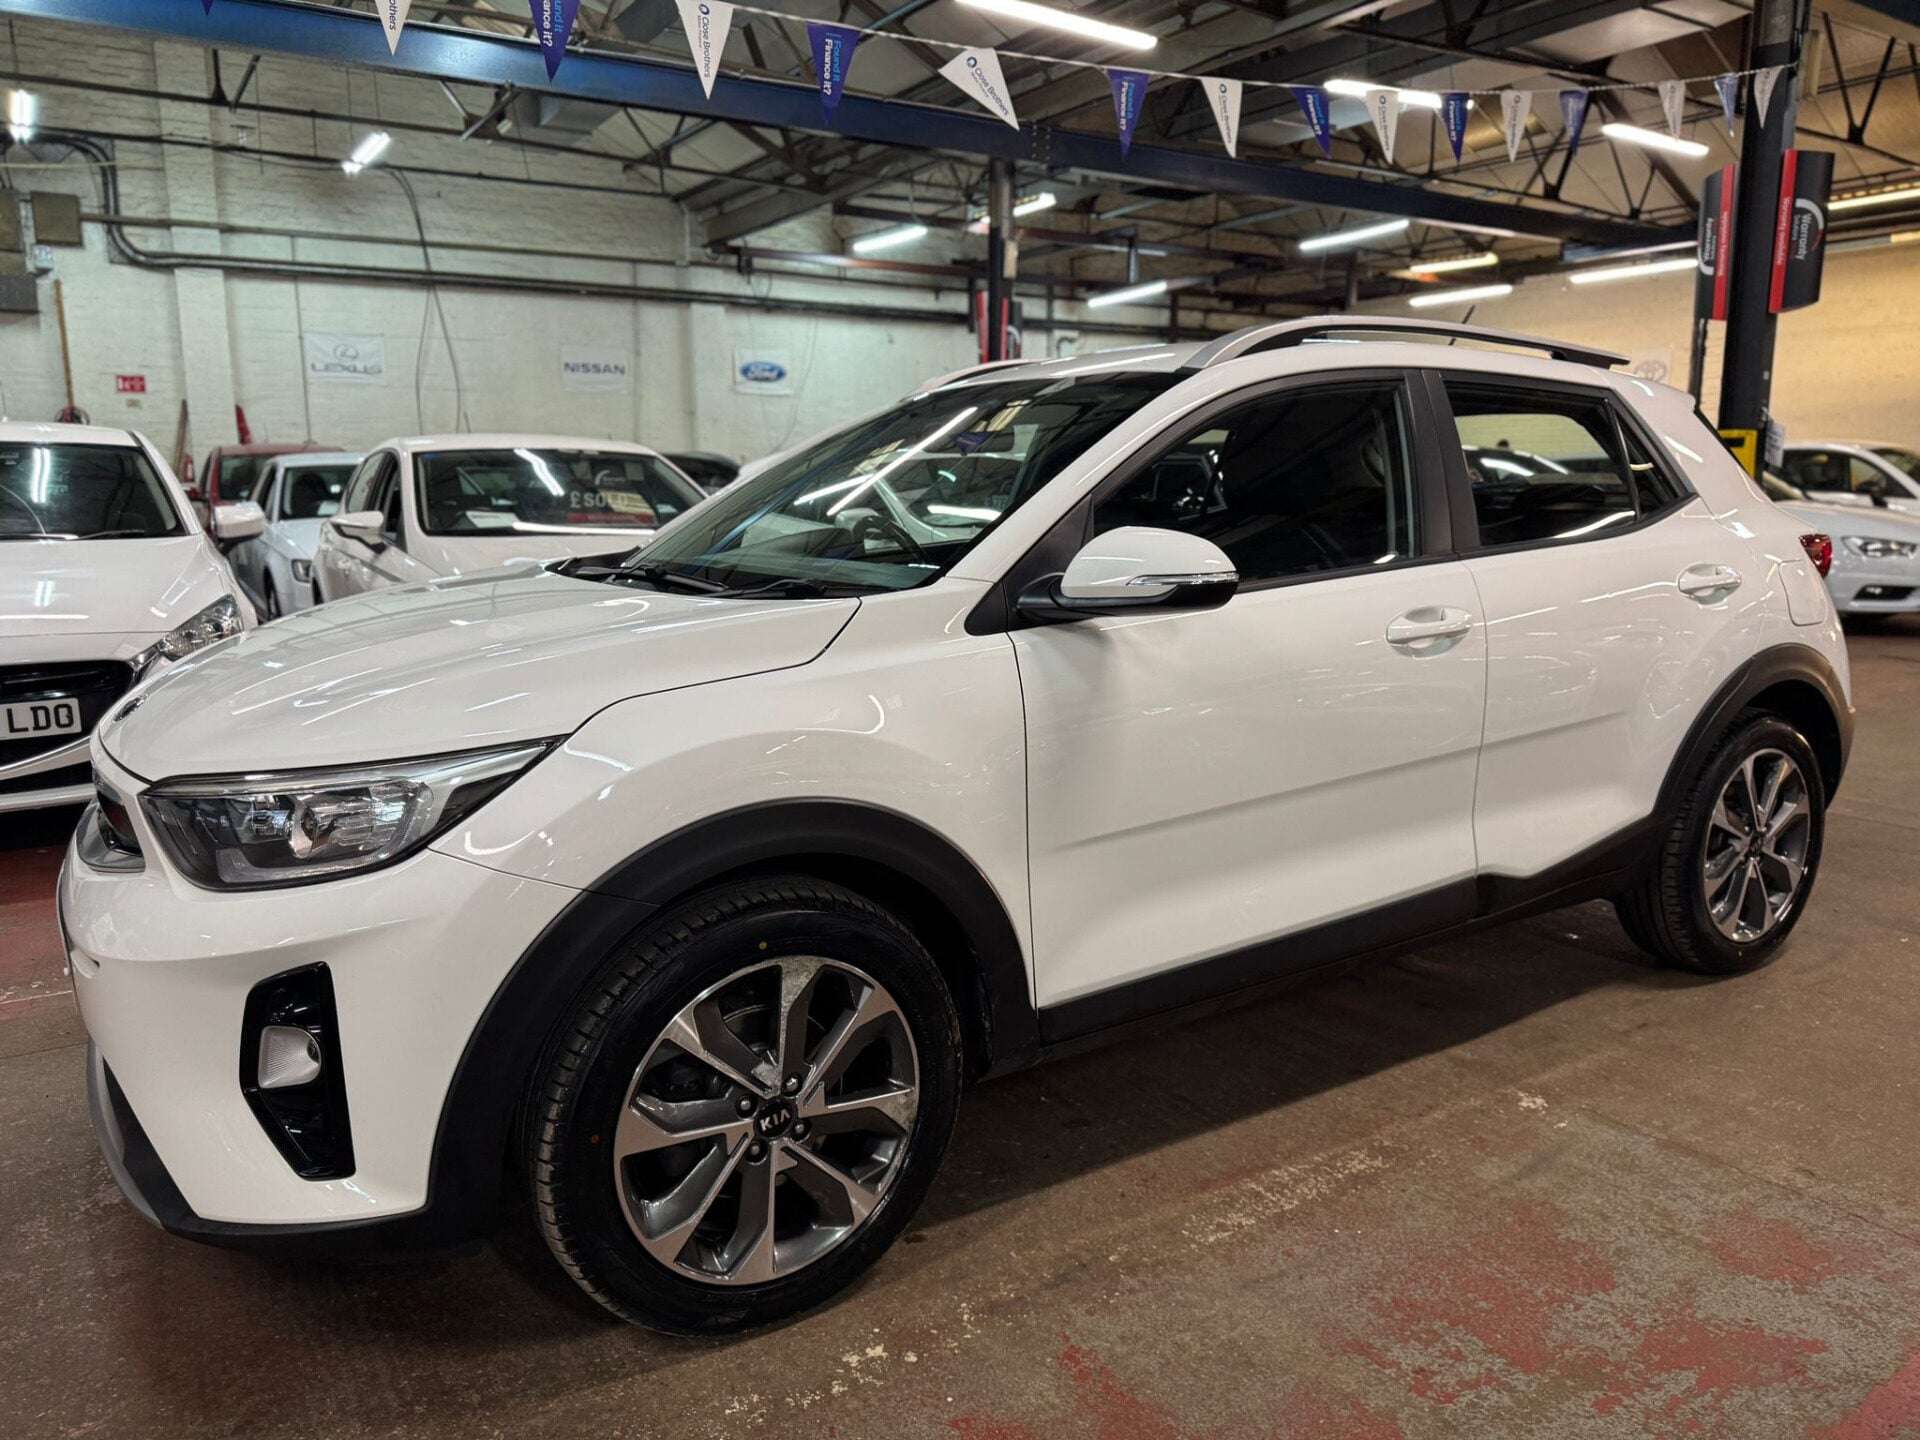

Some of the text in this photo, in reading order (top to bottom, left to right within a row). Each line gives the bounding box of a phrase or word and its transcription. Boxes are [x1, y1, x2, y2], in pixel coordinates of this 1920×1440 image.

[389, 0, 397, 31] others
[543, 0, 553, 47] ance it?
[702, 16, 711, 78] Close Brothers
[832, 39, 842, 74] Found
[823, 38, 833, 96] Finance it?
[975, 67, 989, 88] Close
[987, 86, 1008, 116] Brothers
[1120, 80, 1129, 117] Finance
[1795, 213, 1813, 260] Warranty
[310, 362, 382, 375] LEXUS
[564, 362, 625, 375] NISSAN
[760, 1109, 791, 1132] KIA
